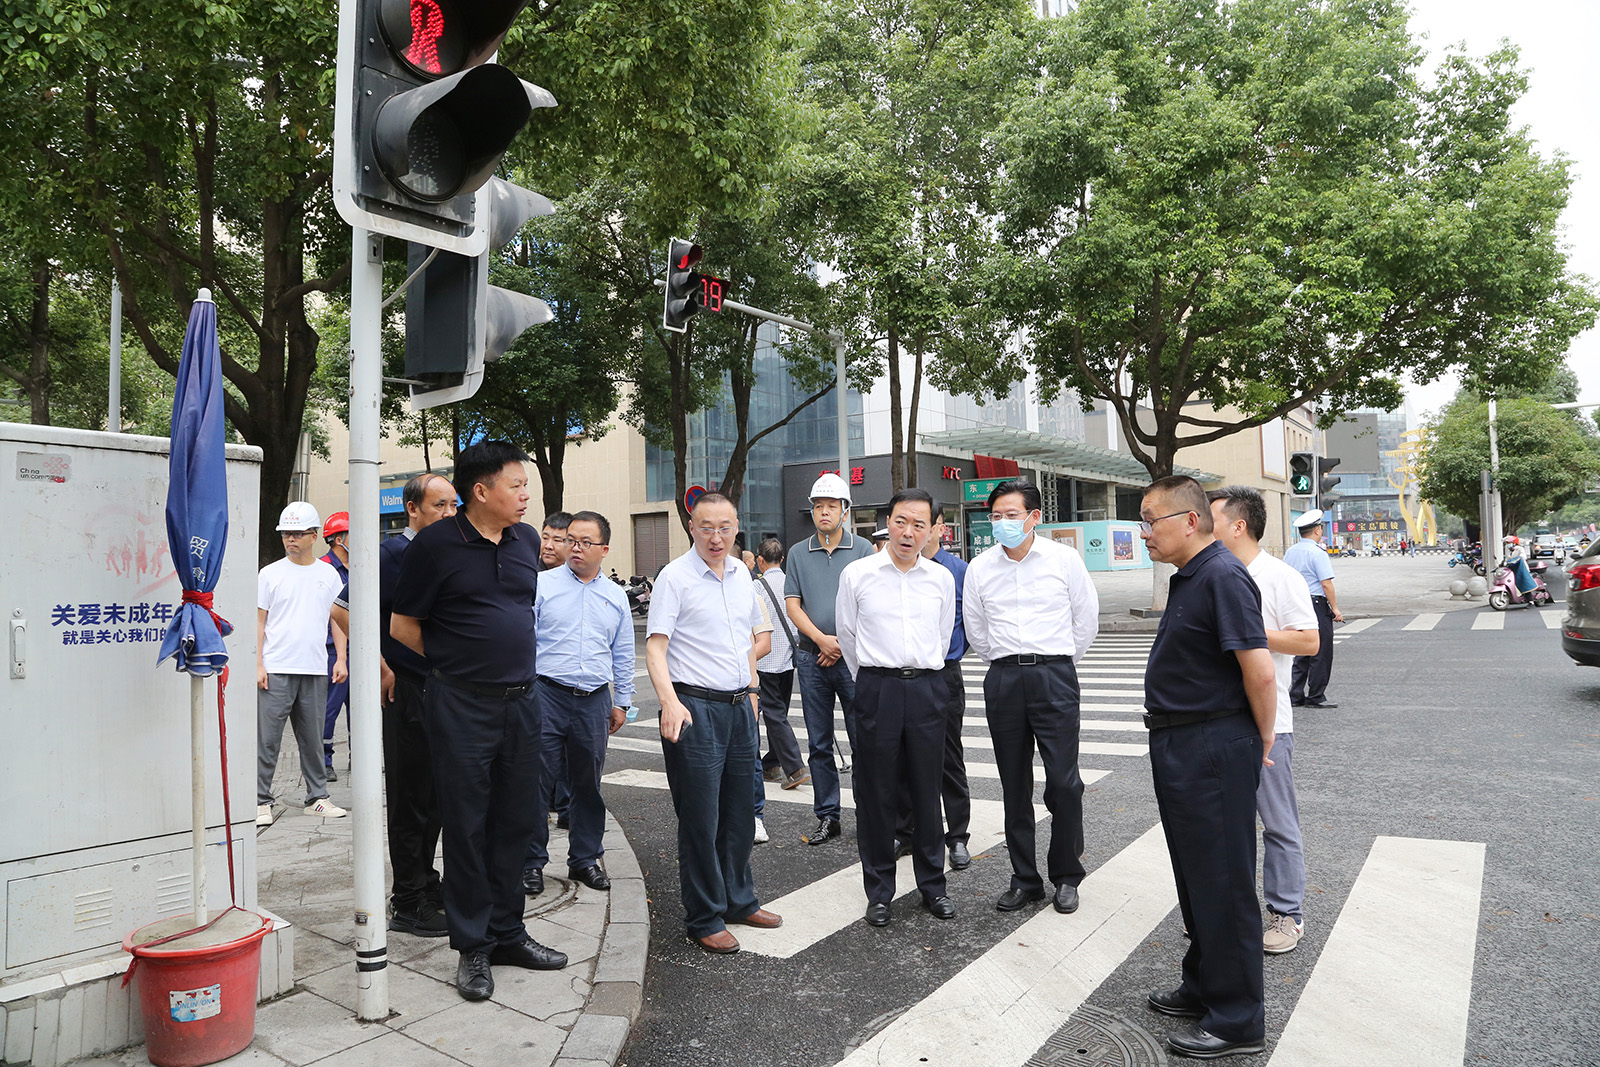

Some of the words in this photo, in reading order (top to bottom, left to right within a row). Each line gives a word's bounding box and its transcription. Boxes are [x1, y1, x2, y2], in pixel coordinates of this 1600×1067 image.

[701, 278, 721, 312] 19
[943, 466, 962, 480] KFC
[382, 495, 403, 506] Walm
[51, 602, 173, 627] 关爱未成年
